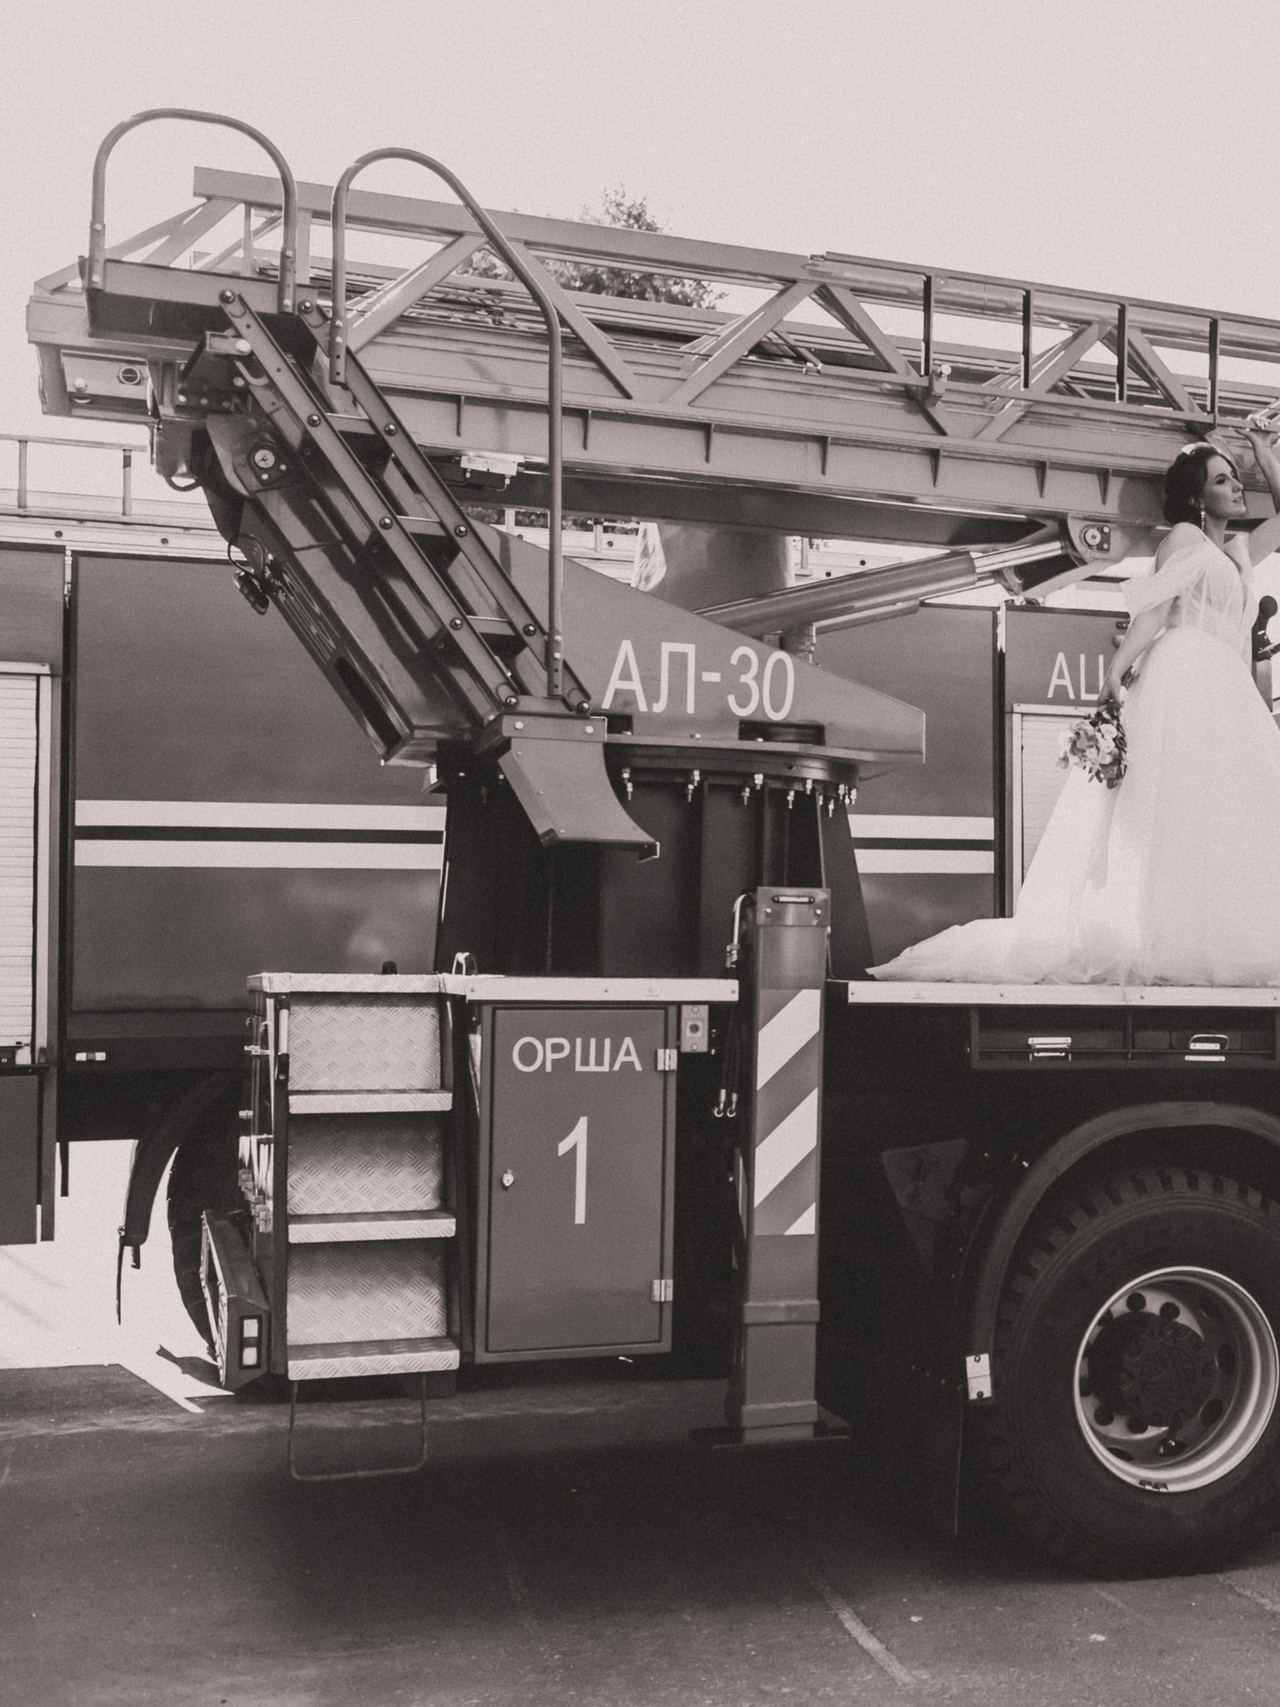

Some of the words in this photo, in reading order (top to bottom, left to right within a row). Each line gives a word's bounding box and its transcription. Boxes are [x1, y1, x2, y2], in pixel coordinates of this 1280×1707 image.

[601, 640, 795, 721] АЛ-30
[512, 1036, 643, 1073] ОРША
[558, 1116, 588, 1225] 1
